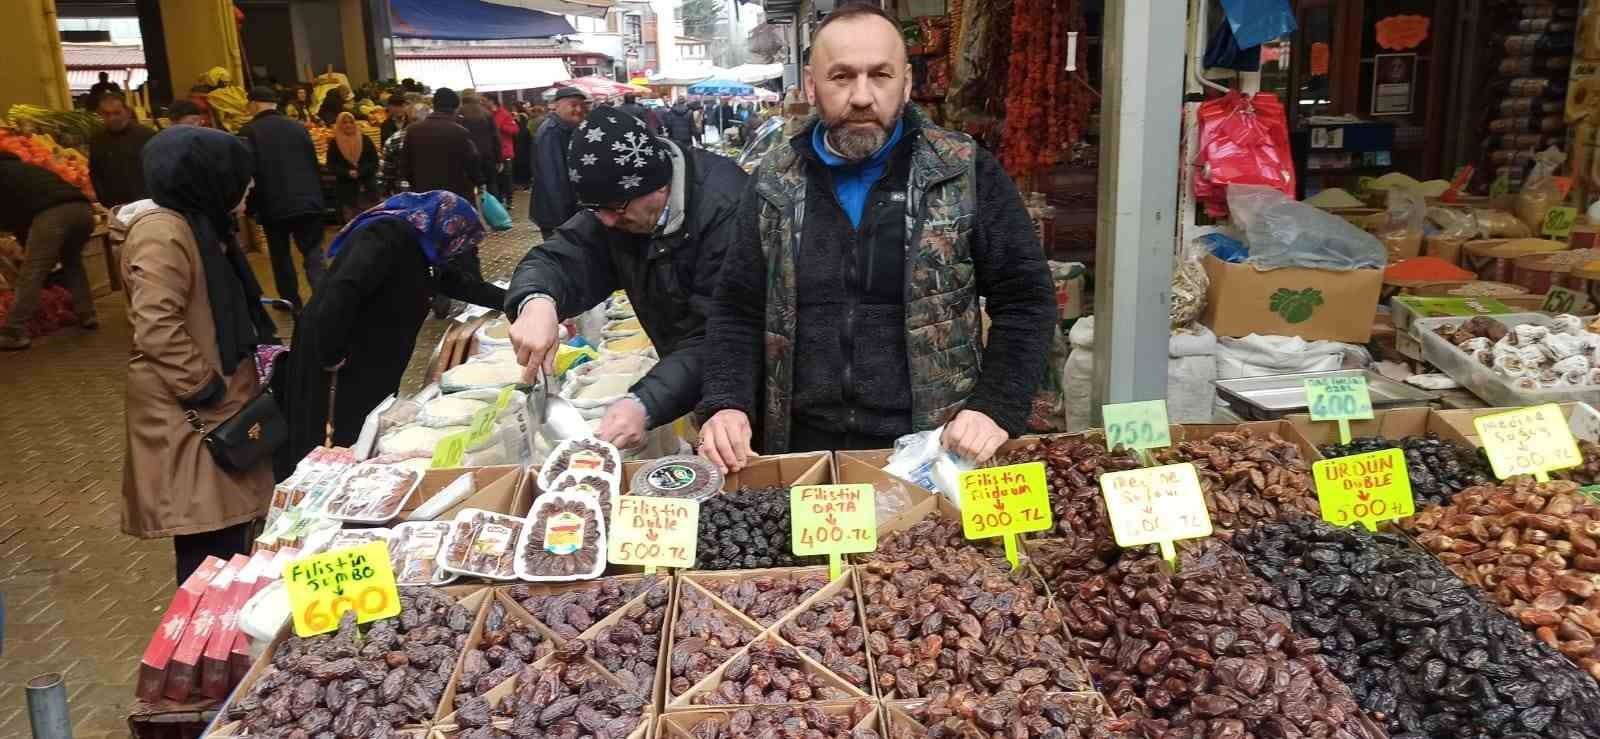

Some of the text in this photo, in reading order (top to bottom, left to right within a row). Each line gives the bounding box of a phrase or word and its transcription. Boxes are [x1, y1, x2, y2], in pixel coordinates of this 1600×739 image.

[1325, 455, 1393, 480] ÜRDÜN
[965, 472, 1026, 489] Filistin
[619, 499, 689, 518] Filistin
[971, 511, 1013, 532] 300
